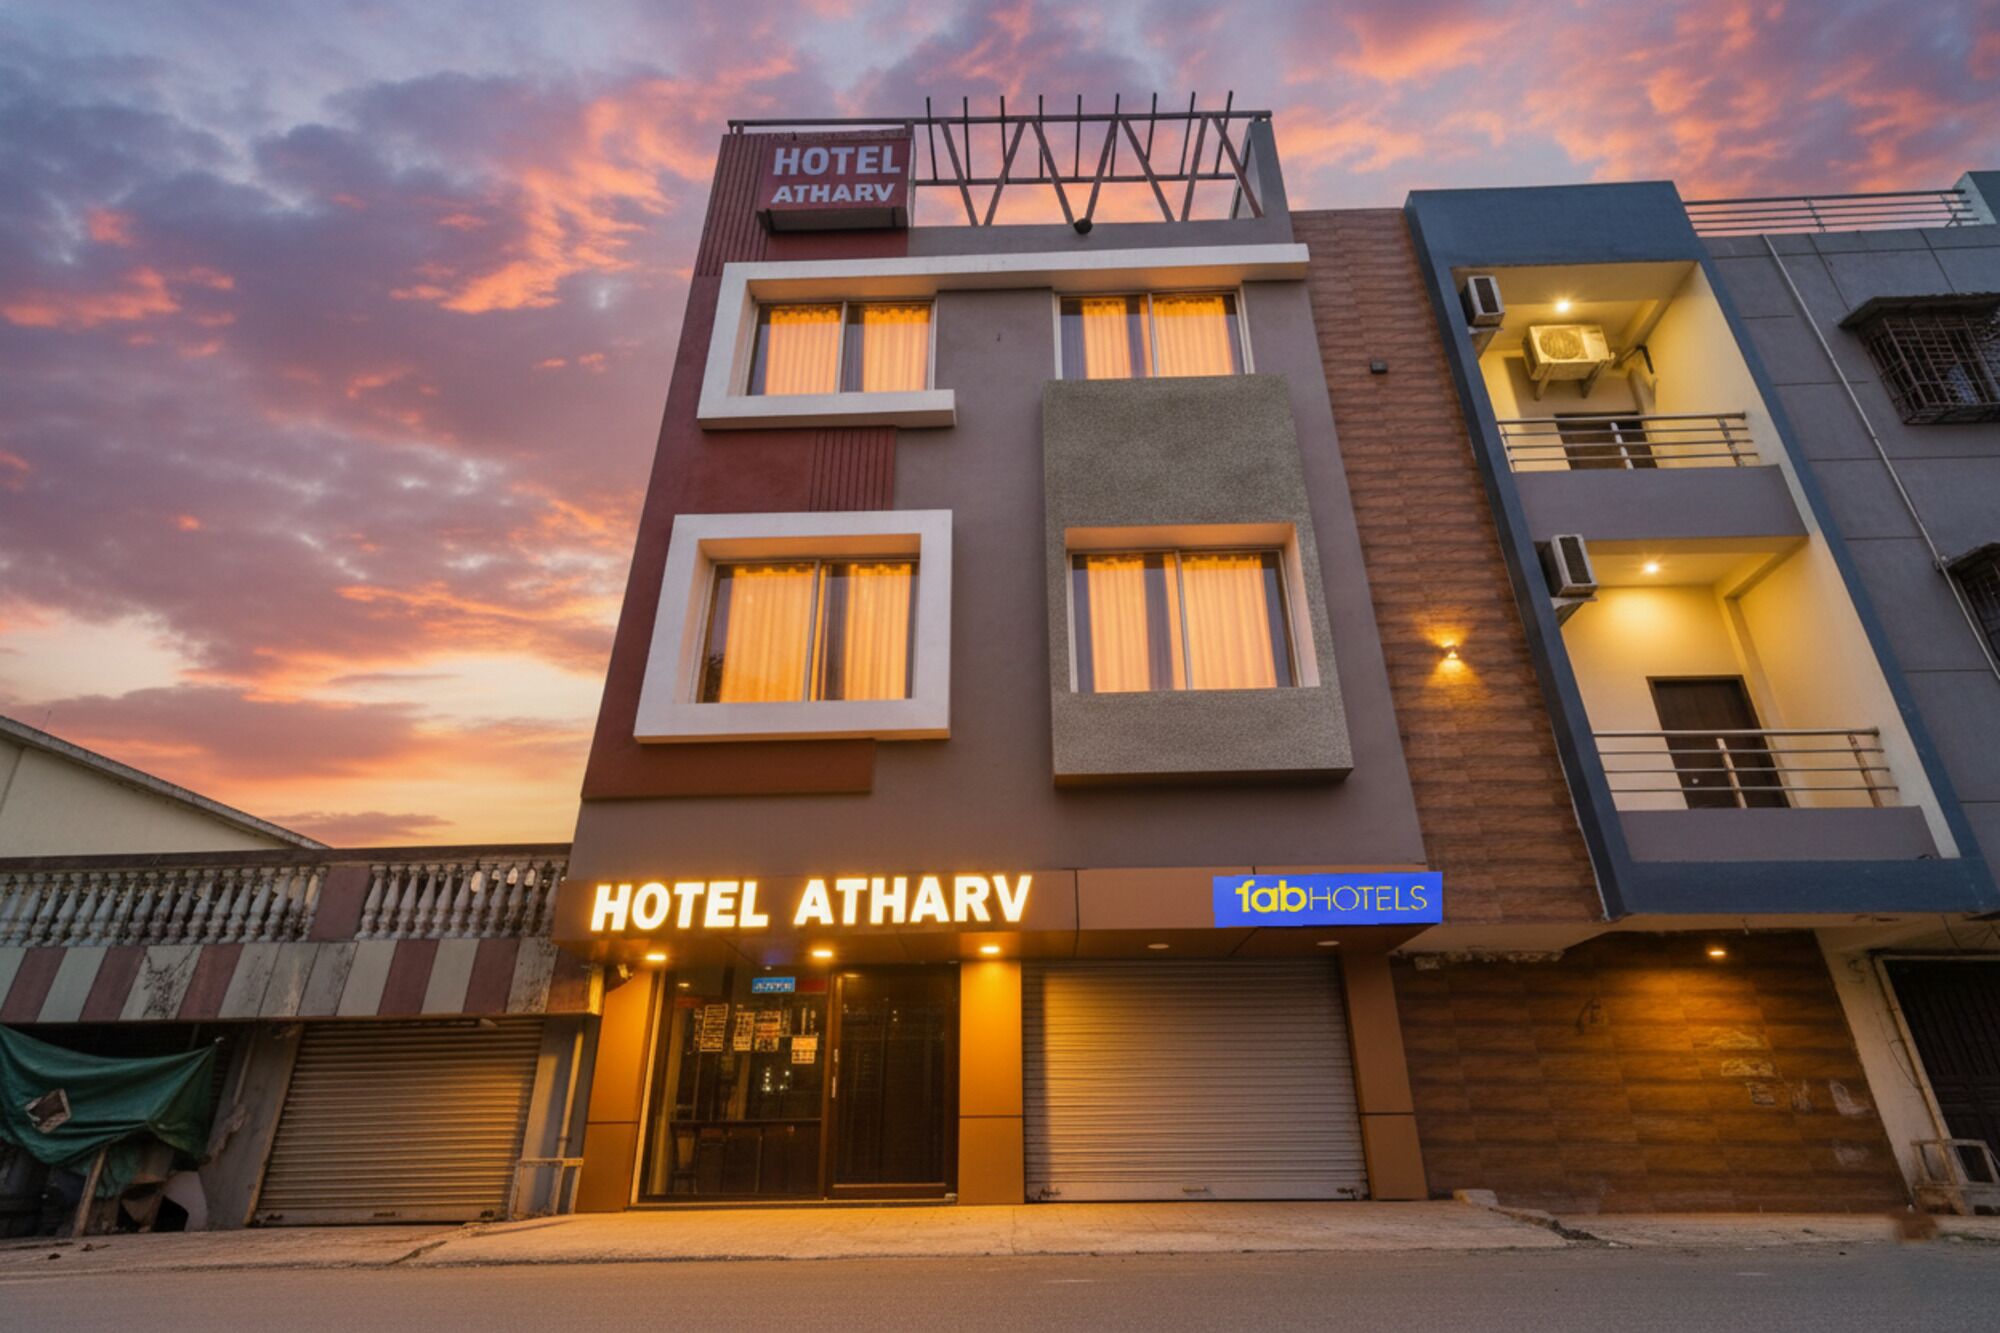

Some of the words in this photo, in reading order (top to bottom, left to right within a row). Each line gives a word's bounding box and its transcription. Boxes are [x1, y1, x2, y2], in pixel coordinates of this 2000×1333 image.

[773, 146, 901, 176] HOTEL
[771, 183, 896, 204] ATHARV
[590, 881, 769, 932] HOTEL
[793, 875, 1033, 925] ATHARV
